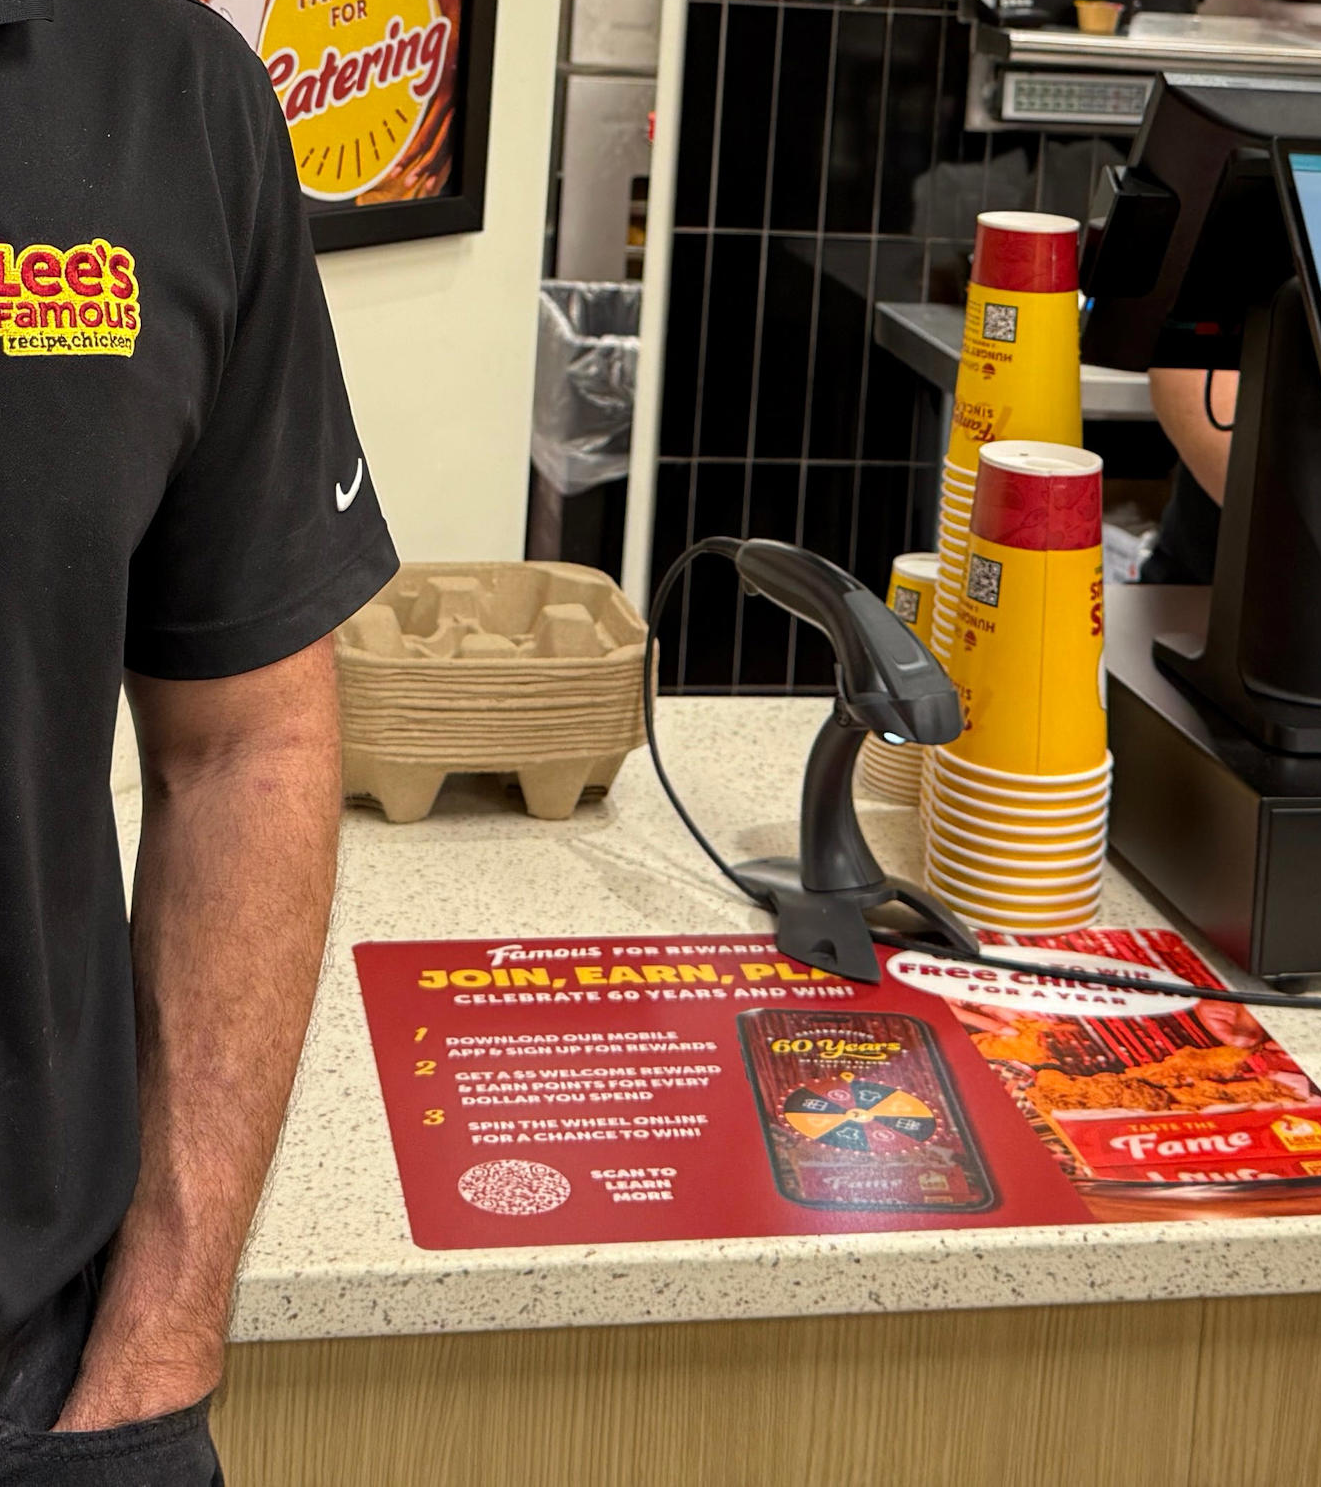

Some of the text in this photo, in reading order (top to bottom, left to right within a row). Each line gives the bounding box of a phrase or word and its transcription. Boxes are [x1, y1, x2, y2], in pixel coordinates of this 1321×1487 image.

[331, 0, 368, 28] FOR
[267, 21, 447, 122] Catering
[486, 944, 778, 966] Famous FOR REWARDS
[418, 967, 567, 989] JOIN,
[574, 964, 734, 985] EARN,
[454, 985, 855, 1005] CELEBRATE 60 YEARS AND WIN!
[968, 984, 1127, 1006] FOR A YEAR
[414, 1027, 428, 1042] 1
[445, 1031, 678, 1047] DOWNLOAD OUR MOBILE
[447, 1047, 486, 1059] APP
[505, 1045, 553, 1056] SIGN
[555, 1044, 583, 1055] UP
[584, 1043, 623, 1054] FOR
[626, 1041, 718, 1053] REWARDS
[771, 1038, 902, 1060] 60 Years
[414, 1060, 437, 1076] 2
[454, 1070, 494, 1082] GET
[496, 1070, 511, 1081] A
[539, 1067, 638, 1080] WELCOME
[640, 1064, 722, 1077] REWARD
[475, 1081, 529, 1093] EARN
[532, 1080, 606, 1091] POINTS
[608, 1079, 648, 1090] FOR
[650, 1077, 710, 1089] EVERY
[461, 1091, 654, 1106] DOLLAR YOU SPEND
[422, 1109, 446, 1125] 3
[467, 1115, 709, 1132] SPIN THE WHEEL ONLINE
[471, 1127, 702, 1145] FOR A CHANCE TO WIN!
[1110, 1131, 1252, 1159] Fame
[590, 1167, 677, 1180] SCAN TO
[605, 1179, 673, 1191] LEARN
[612, 1191, 674, 1203] MORE
